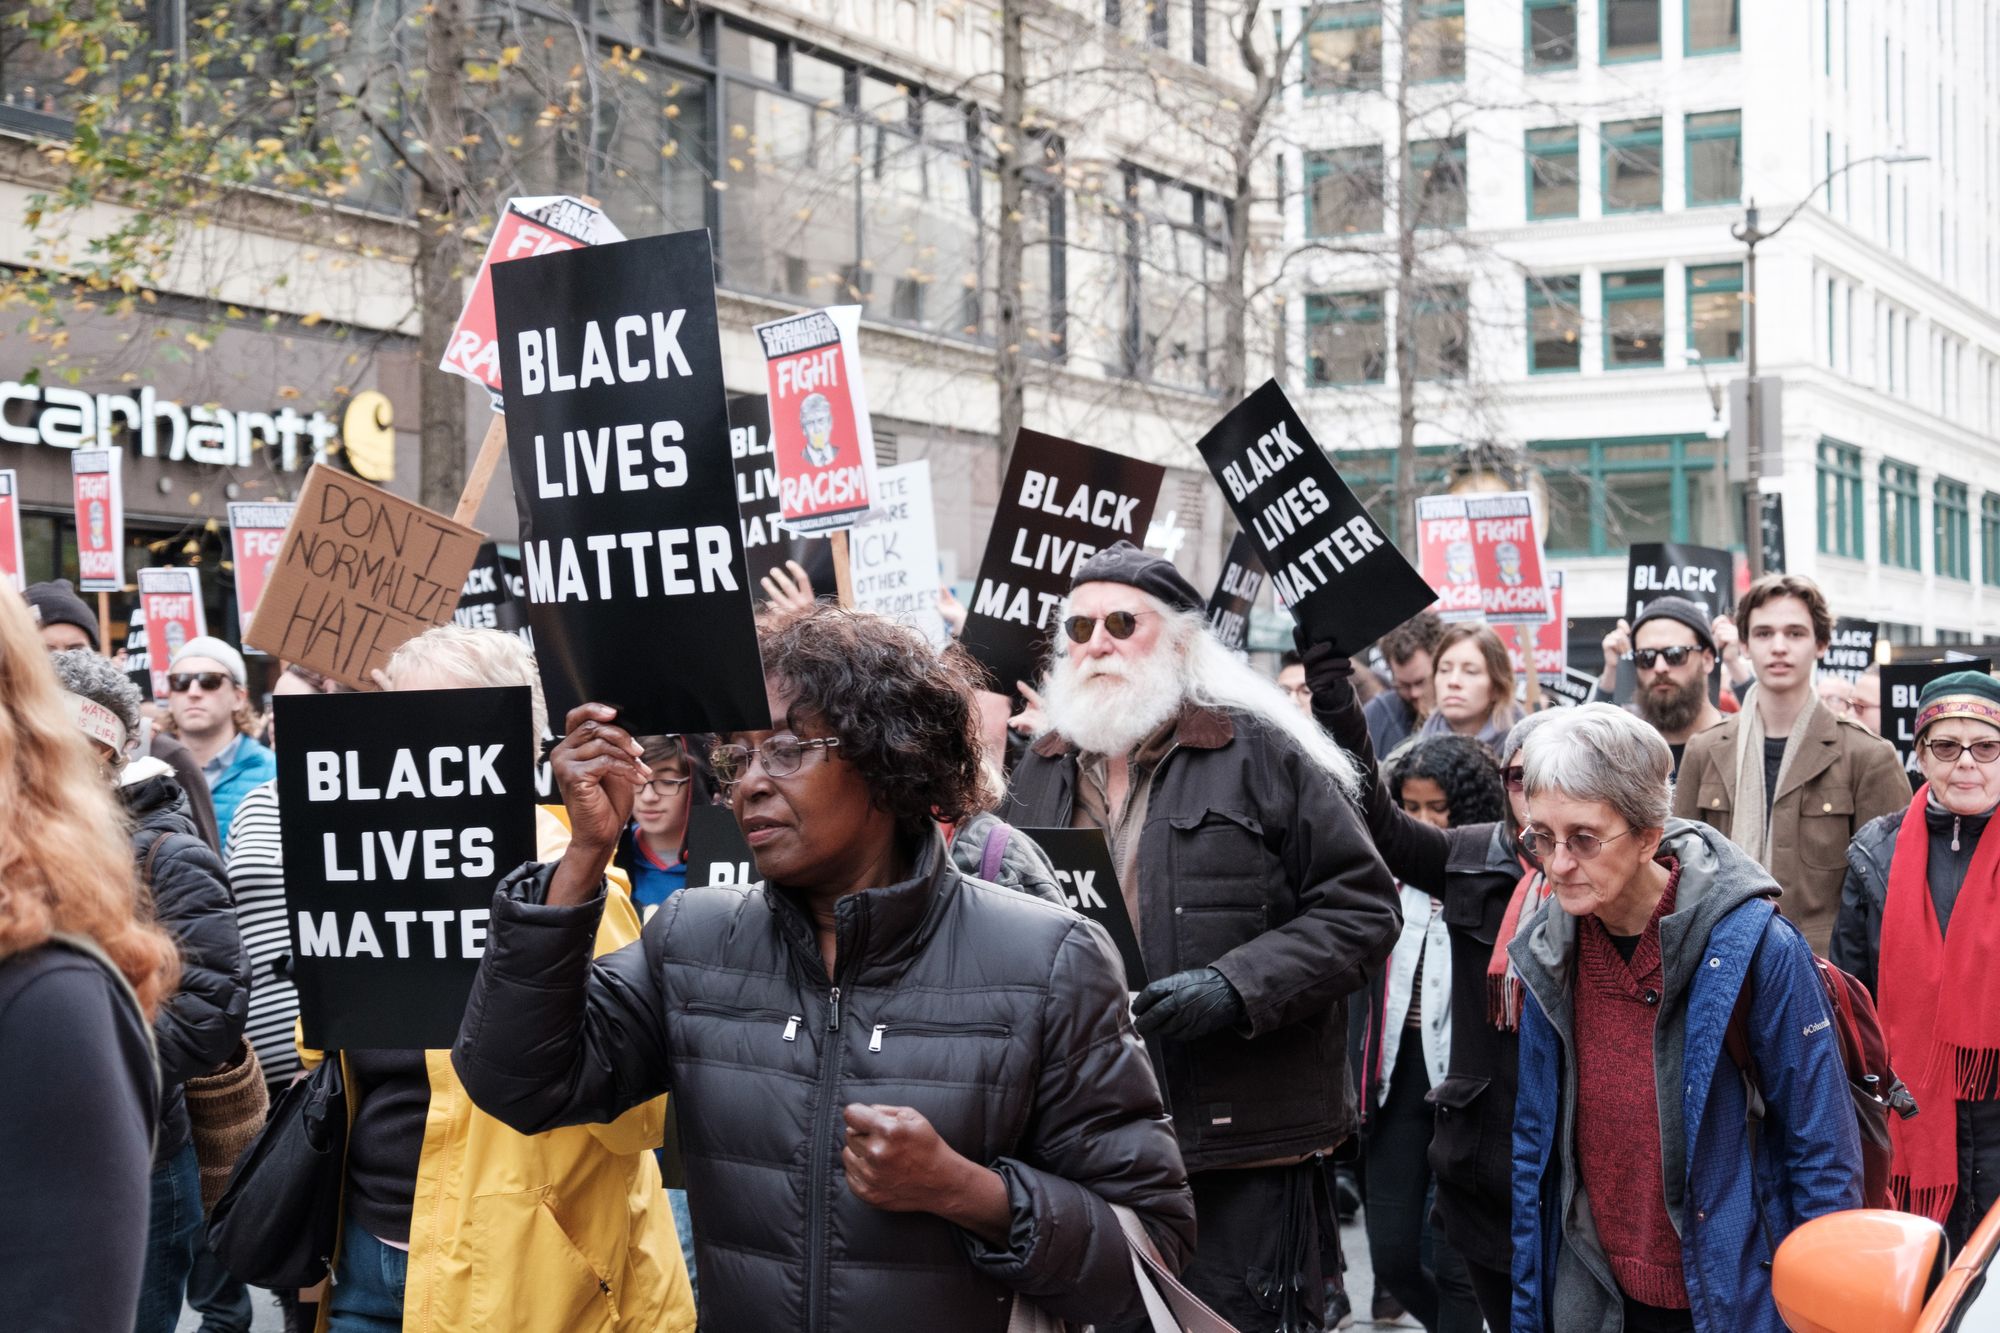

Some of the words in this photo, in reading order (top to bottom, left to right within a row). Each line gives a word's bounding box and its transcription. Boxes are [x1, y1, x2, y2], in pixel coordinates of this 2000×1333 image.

[518, 308, 693, 396] BLACK
[776, 347, 840, 398] FIGHT
[0, 381, 339, 473] carhartt
[534, 420, 688, 499] LIVES
[1221, 420, 1304, 503] BLACK
[780, 465, 868, 514] RACISM
[1018, 469, 1141, 534] BLACK
[1252, 477, 1330, 552] LIVES
[318, 484, 463, 577] DON'T
[1010, 528, 1107, 579] LIVE
[1475, 518, 1529, 544] FIGHT
[286, 530, 458, 627] NORMALIZE
[523, 525, 739, 604] MATTER
[1273, 515, 1385, 609] MATTER
[1633, 565, 1718, 594] BLACK
[148, 596, 192, 621] FIGHT
[277, 582, 409, 684] HATE
[974, 578, 1072, 630] MAT
[1823, 649, 1868, 668] LIVES
[81, 702, 117, 725] WATER
[306, 744, 507, 802] BLACK
[323, 826, 495, 882] LIVES
[298, 908, 491, 959] MATTE
